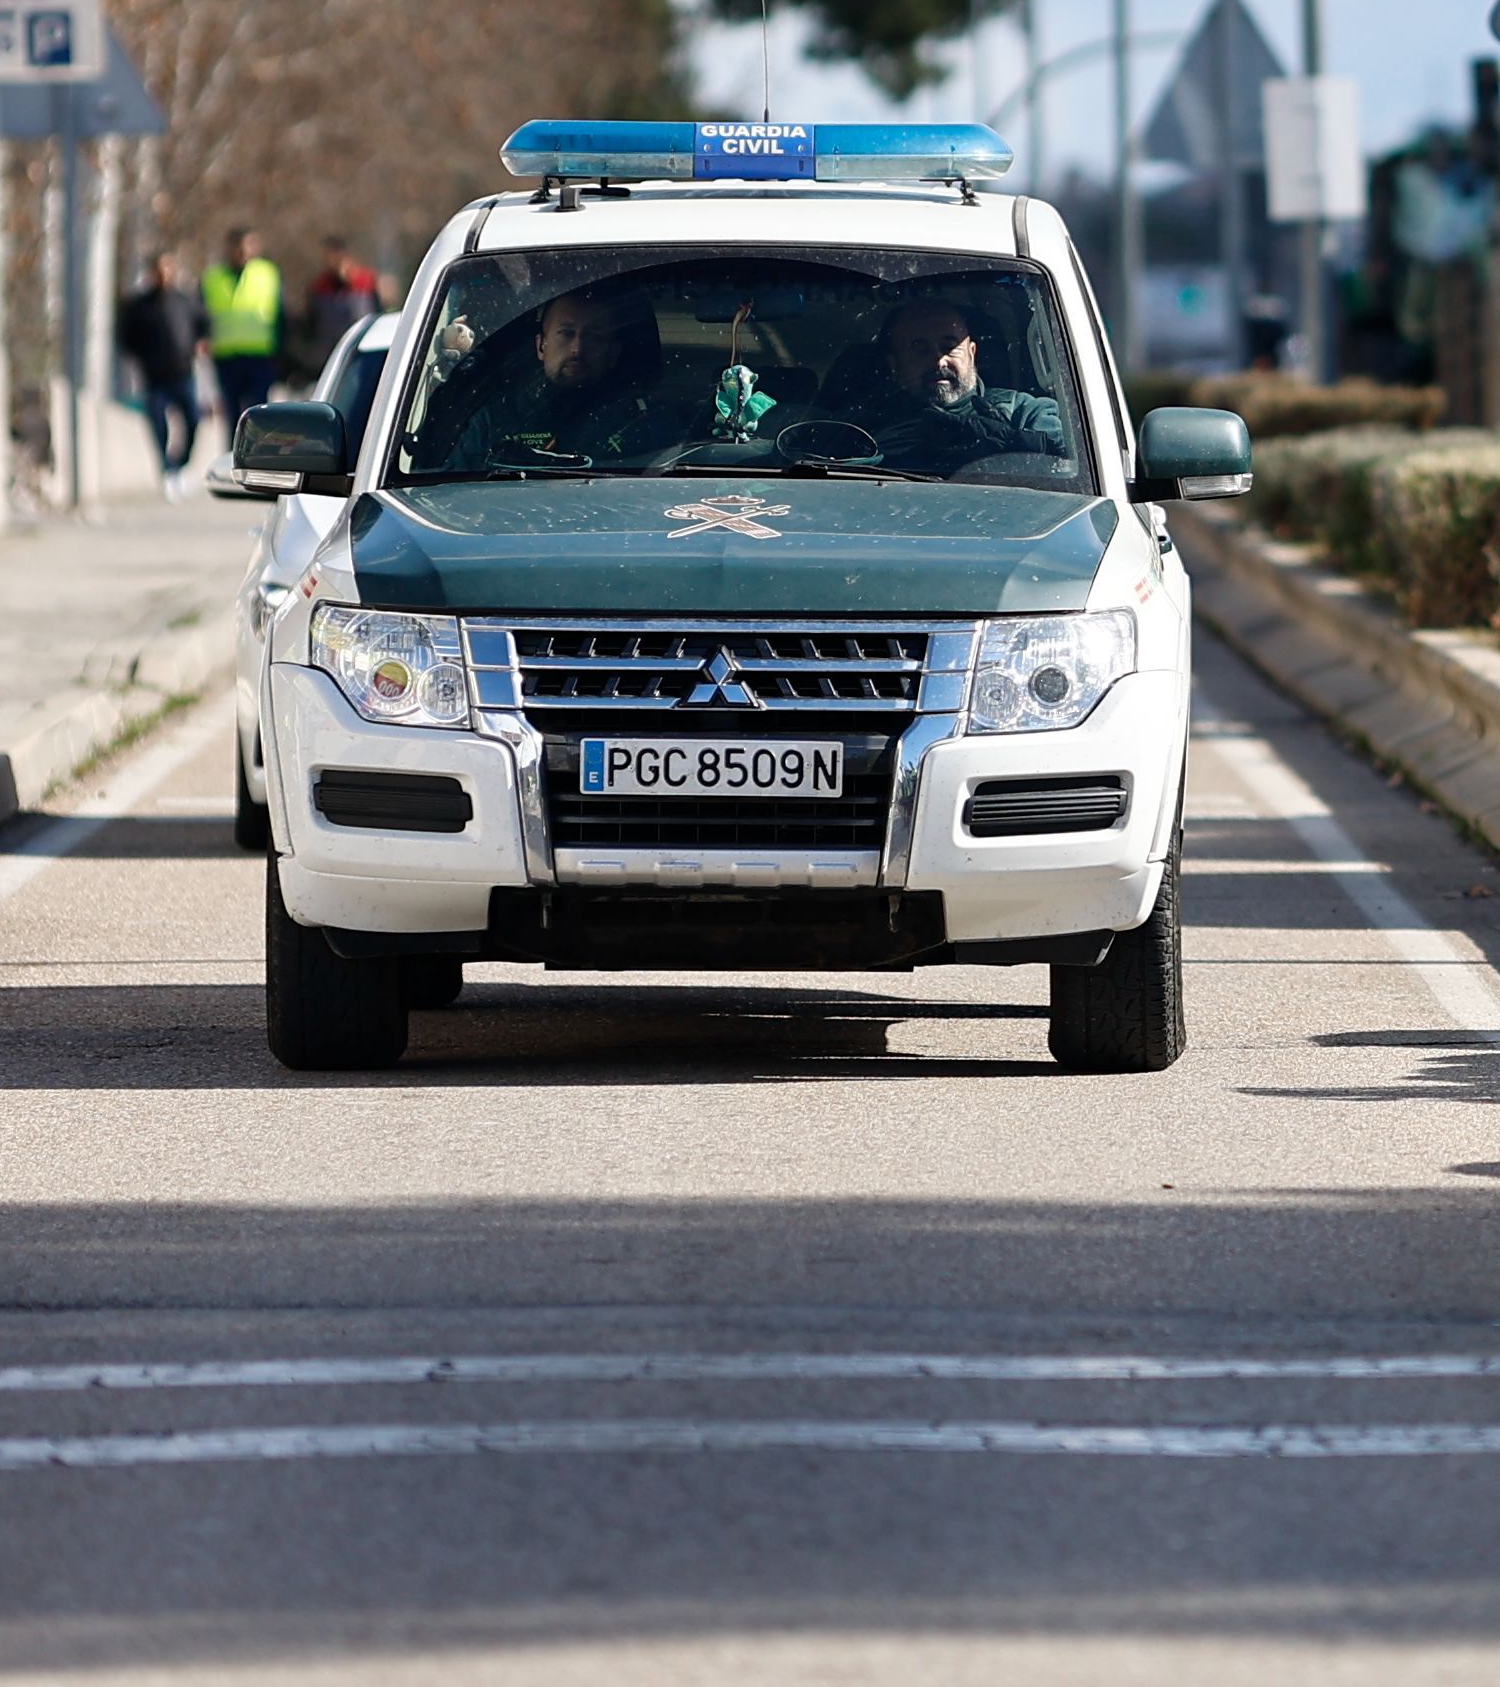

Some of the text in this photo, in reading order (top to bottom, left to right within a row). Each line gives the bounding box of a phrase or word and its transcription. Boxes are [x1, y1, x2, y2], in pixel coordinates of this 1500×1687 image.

[701, 125, 807, 138] GUARDIA
[722, 139, 784, 154] CIVIL
[589, 771, 599, 784] E
